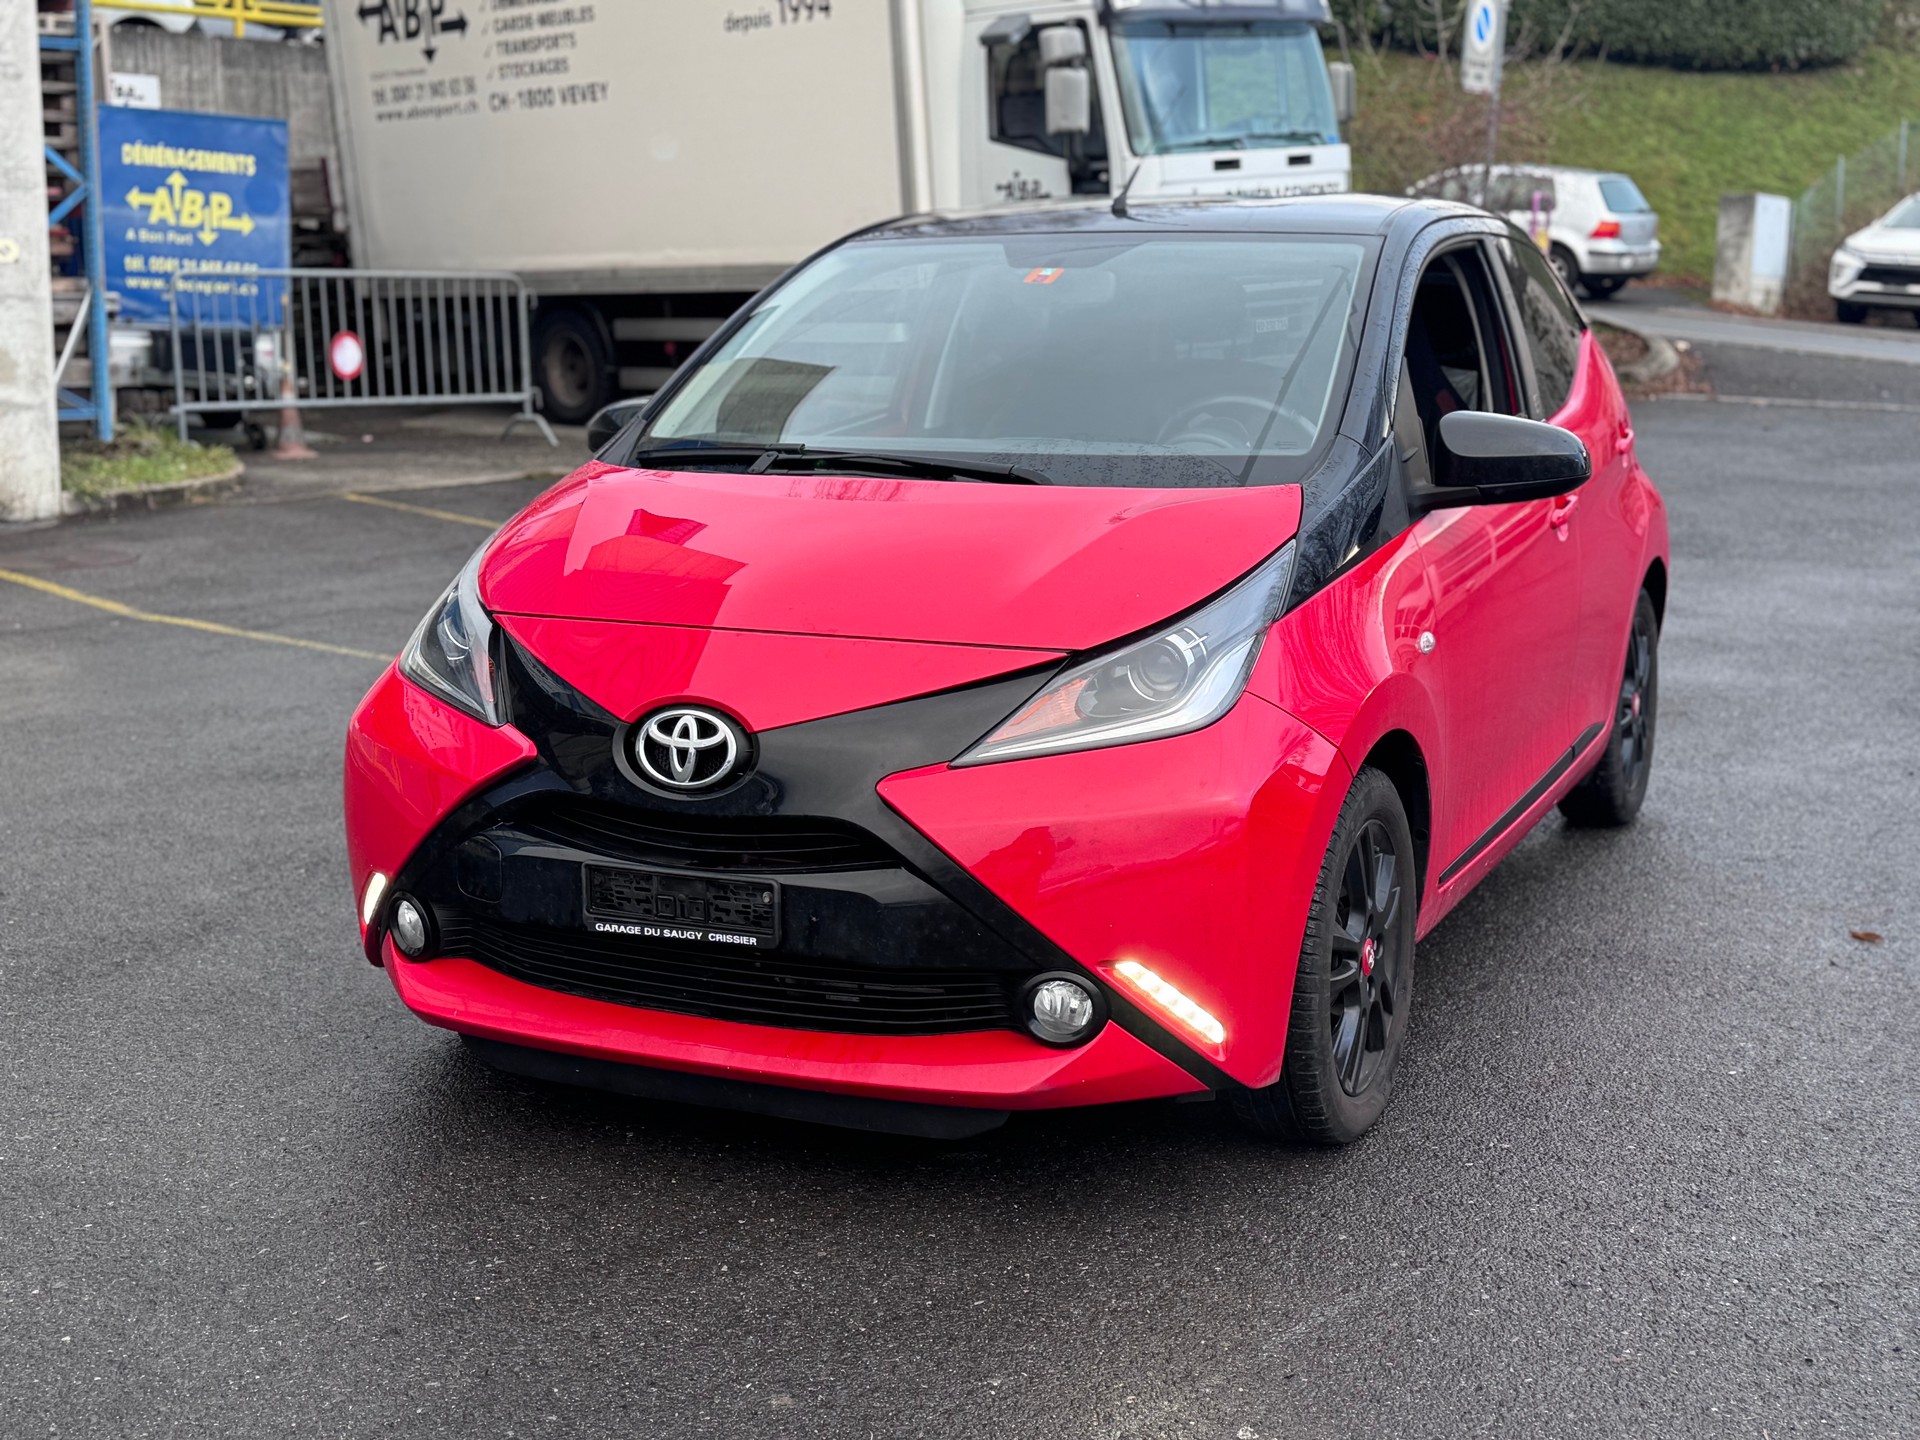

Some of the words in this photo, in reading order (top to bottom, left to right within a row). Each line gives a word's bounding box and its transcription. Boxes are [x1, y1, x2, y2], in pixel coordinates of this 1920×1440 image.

[724, 9, 772, 36] depuis
[496, 32, 577, 56] TRANSPORTS
[499, 56, 569, 80] STOCKAGES
[558, 80, 609, 106] VEVEY
[121, 140, 256, 176] DÉMÉNAGEMENTS
[148, 186, 233, 229] ABP
[595, 923, 641, 935] GARAGE
[644, 927, 660, 937] DU
[663, 929, 702, 940] SAUGY
[708, 933, 757, 946] CRISSIER
